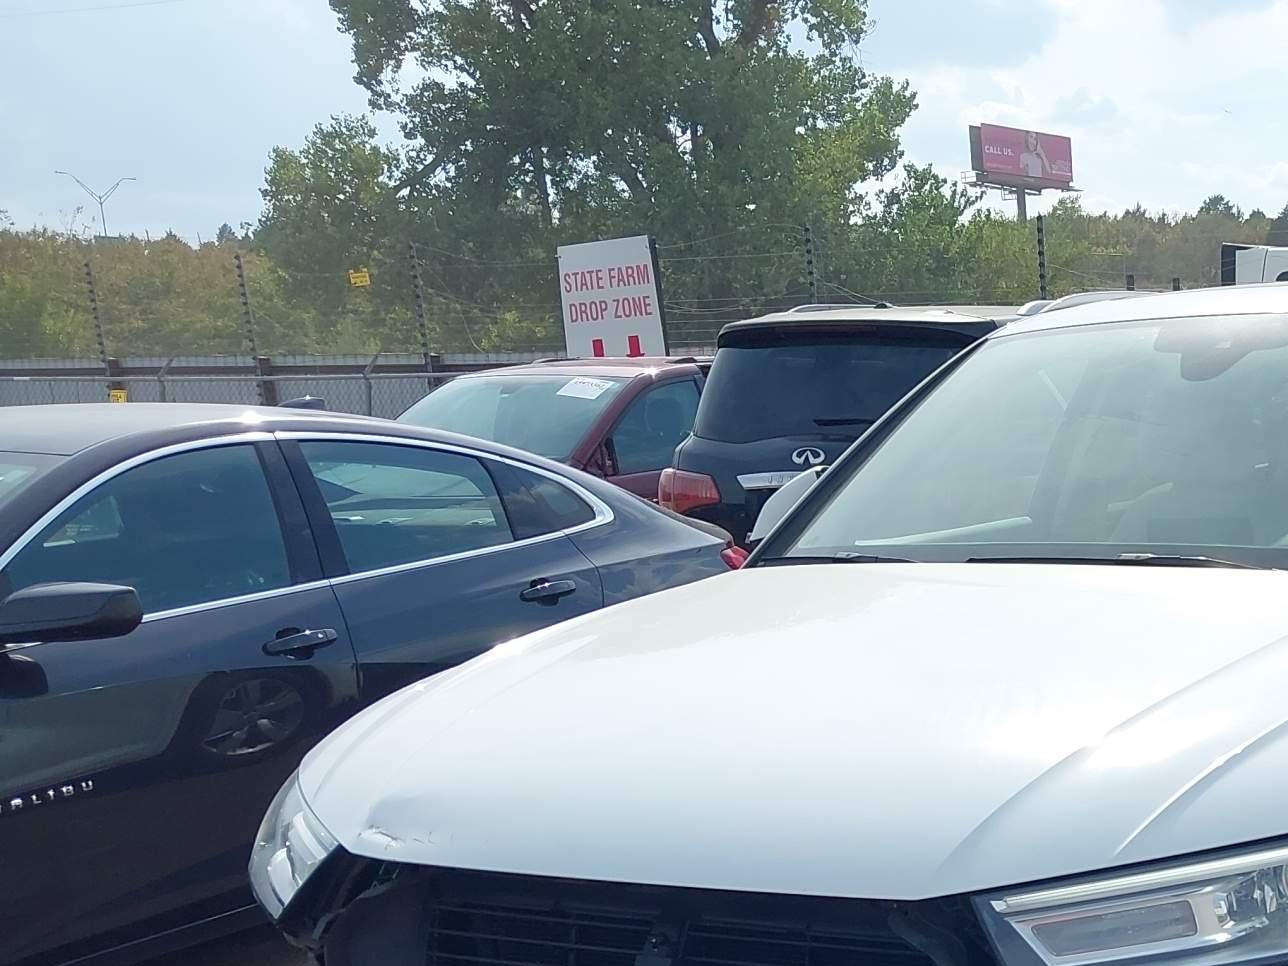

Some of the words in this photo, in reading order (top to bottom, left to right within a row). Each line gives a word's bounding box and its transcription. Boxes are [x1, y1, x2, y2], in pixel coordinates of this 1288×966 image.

[985, 145, 1002, 155] CALL
[563, 269, 605, 293] STATE
[608, 264, 650, 288] FARM
[569, 300, 608, 323] DROP
[612, 296, 653, 319] ZONE
[0, 780, 93, 814] ALIBU
